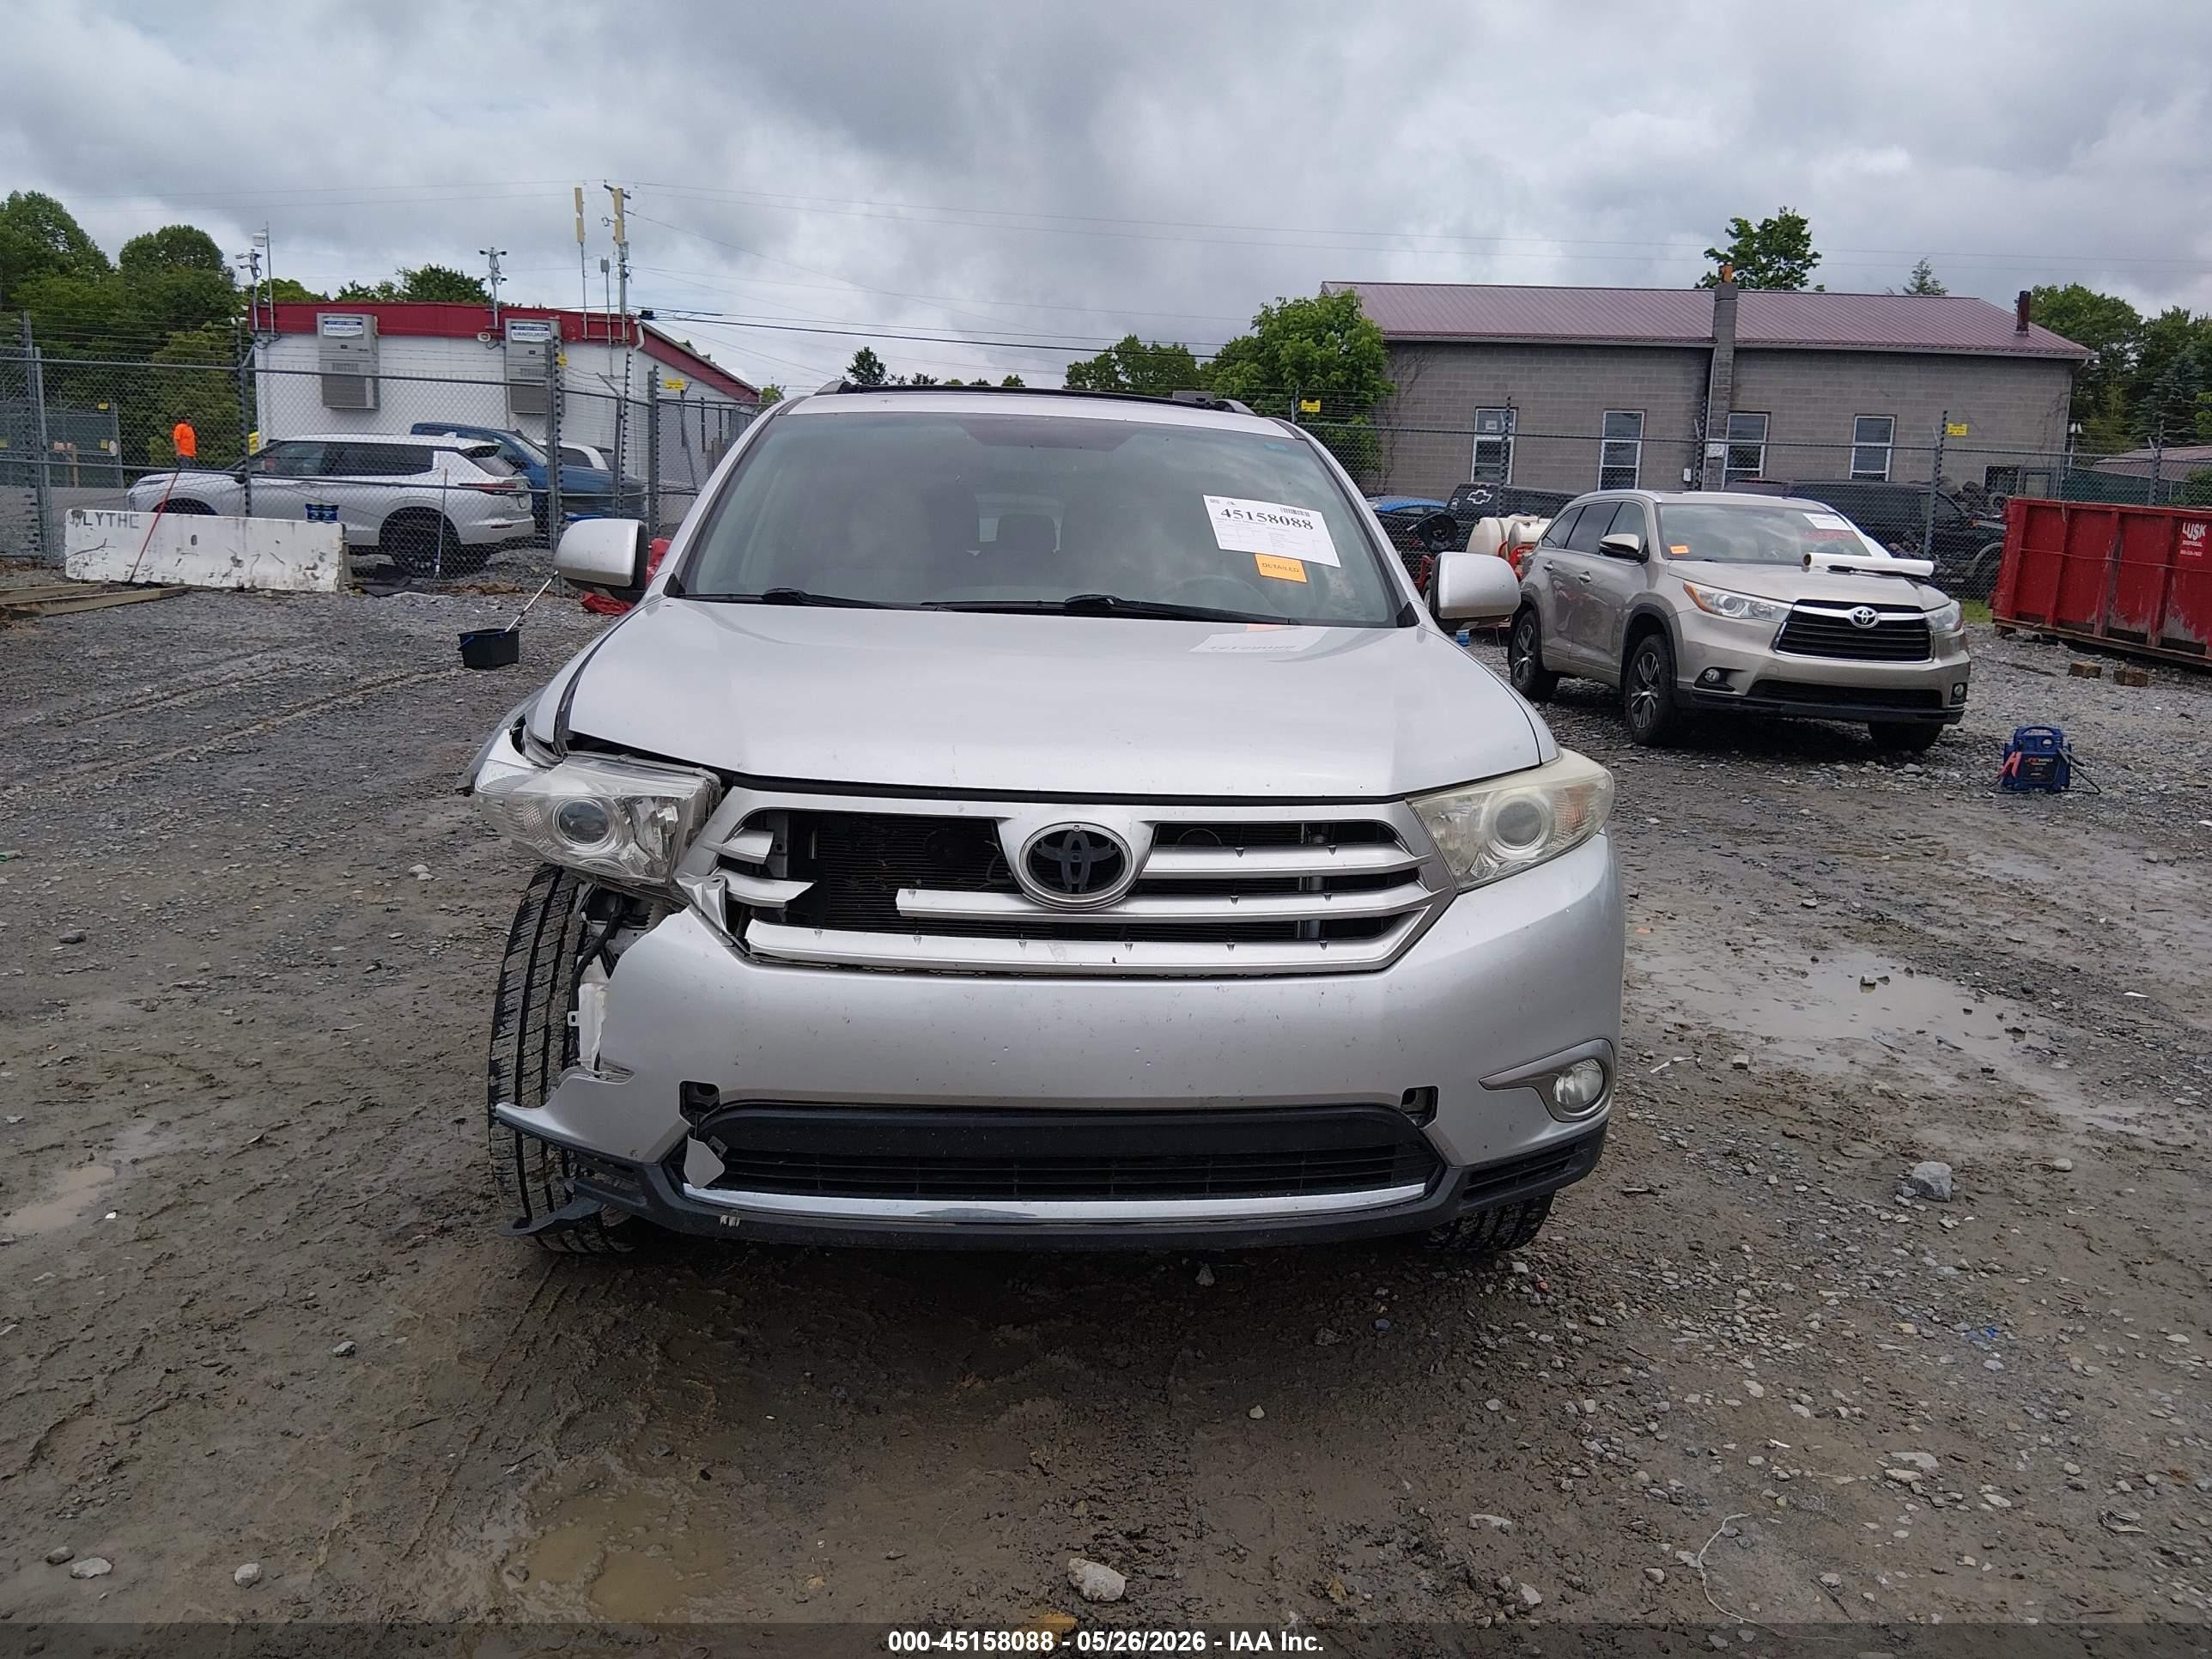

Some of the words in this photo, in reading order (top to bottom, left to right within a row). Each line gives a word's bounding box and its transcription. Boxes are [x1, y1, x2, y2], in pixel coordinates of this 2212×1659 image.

[1220, 508, 1314, 531] 45158088
[2182, 522, 2207, 540] LUSK
[1261, 562, 1299, 573] DETAILED
